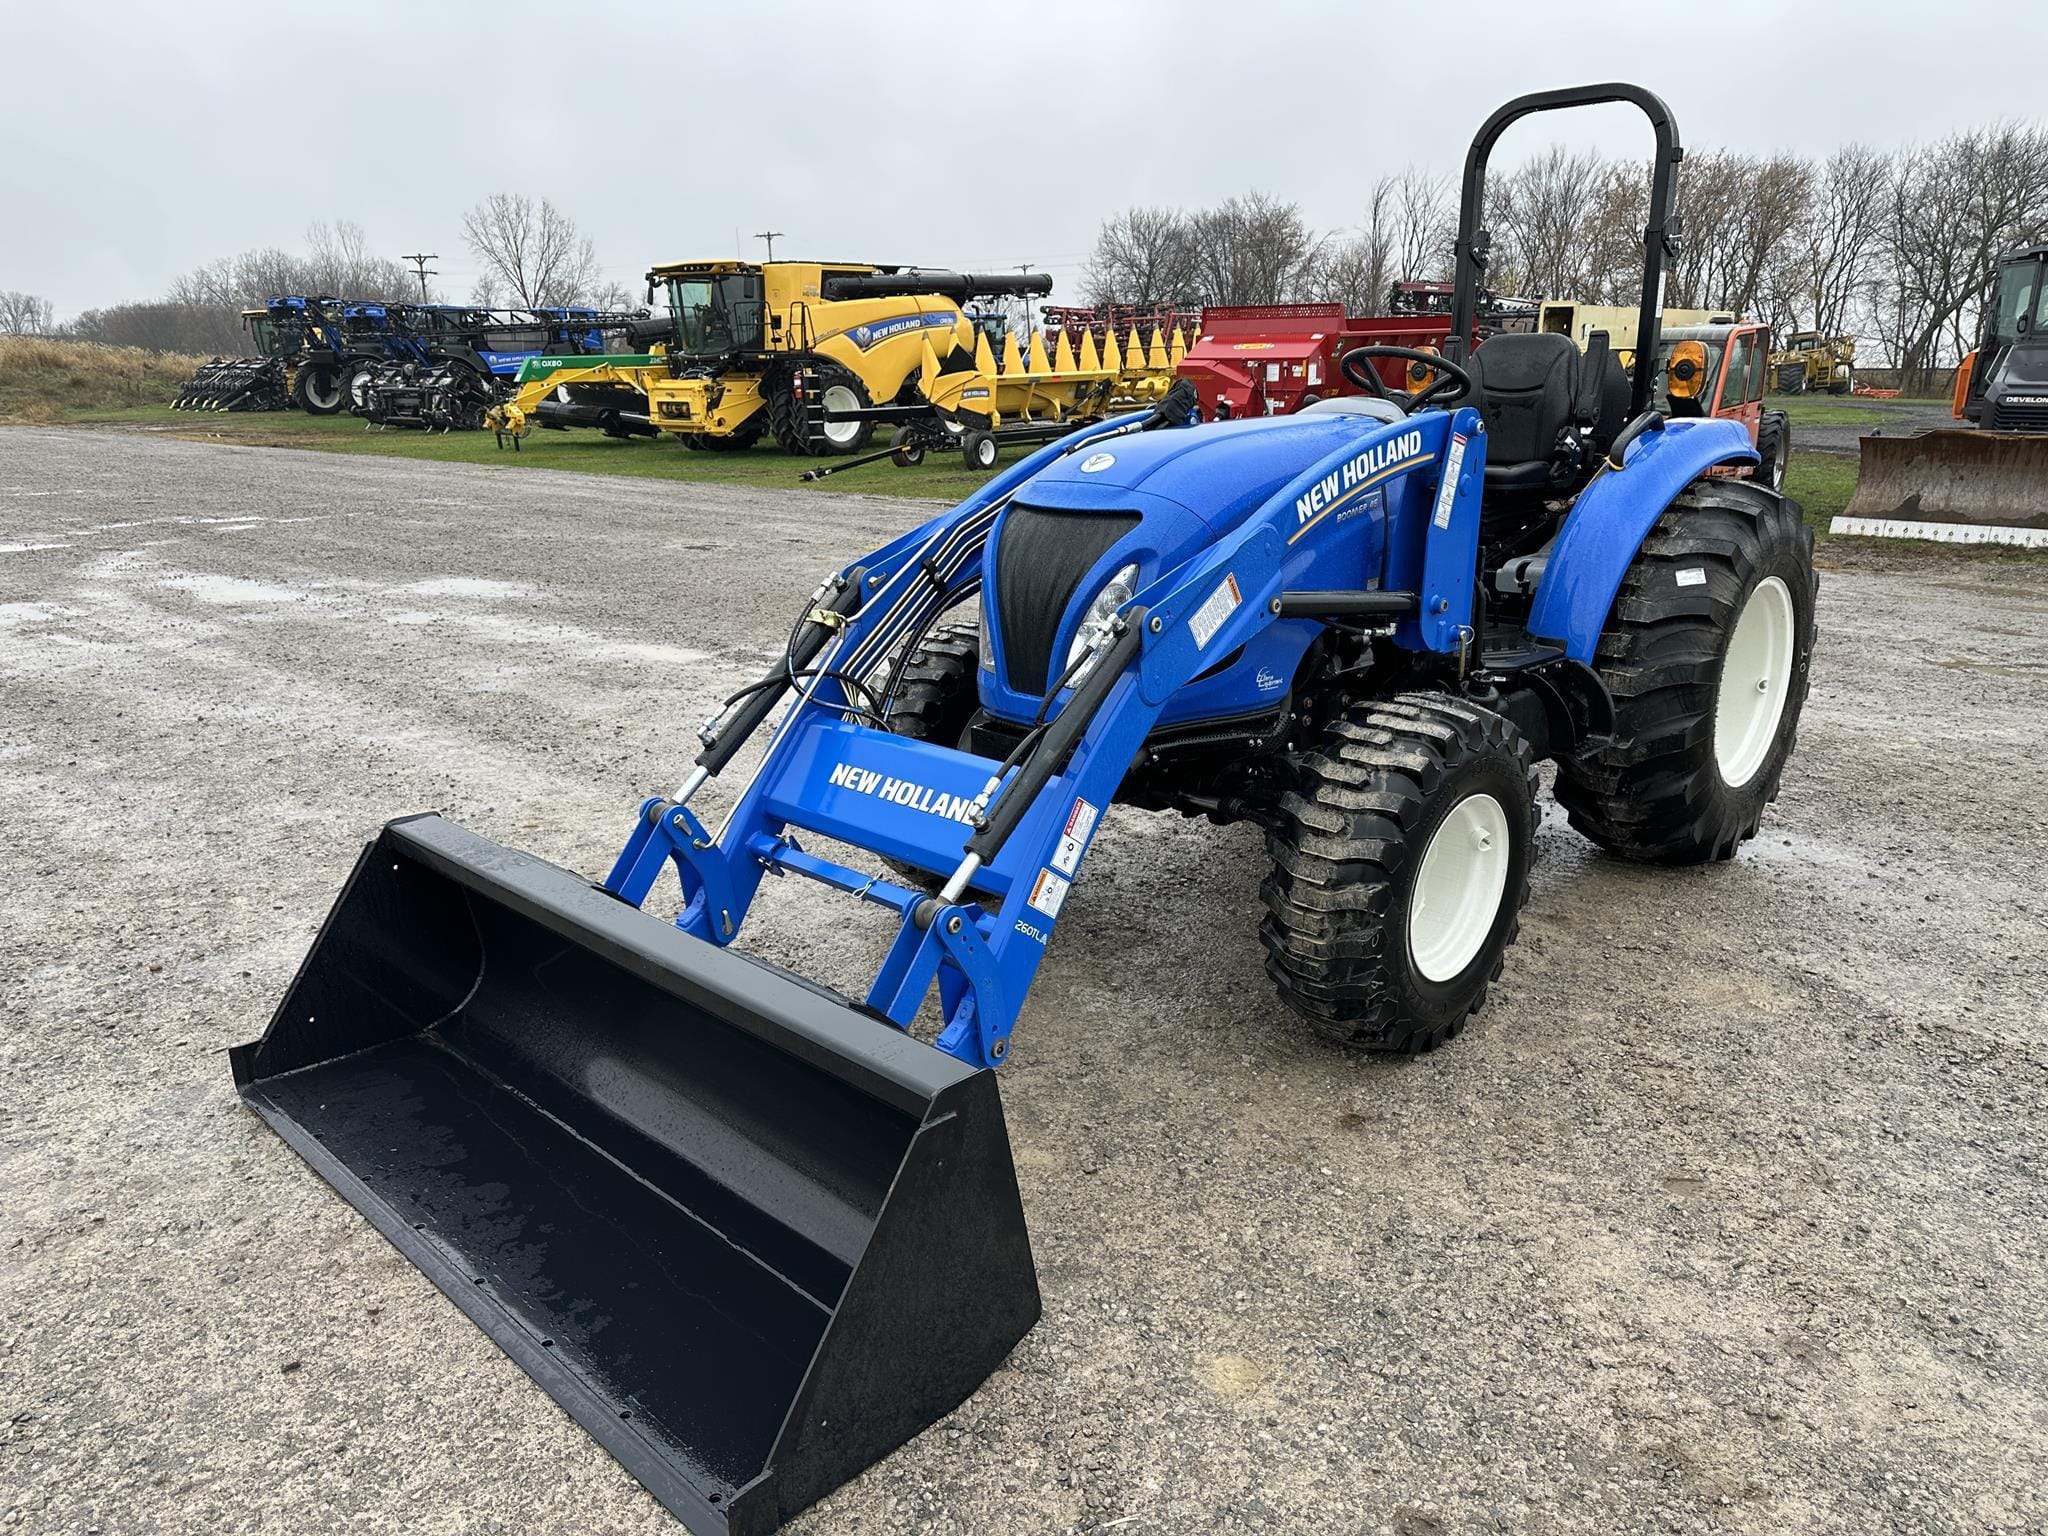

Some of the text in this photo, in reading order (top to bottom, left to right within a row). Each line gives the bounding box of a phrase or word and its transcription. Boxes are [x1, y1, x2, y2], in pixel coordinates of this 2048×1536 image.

[873, 319, 920, 340] NEW HOLLAND
[1296, 470, 1339, 524] NEW
[1342, 430, 1422, 490] HOLLAND
[1336, 503, 1368, 523] BOOMER
[828, 762, 883, 796] NEW
[1014, 919, 1048, 946] 260TLA
